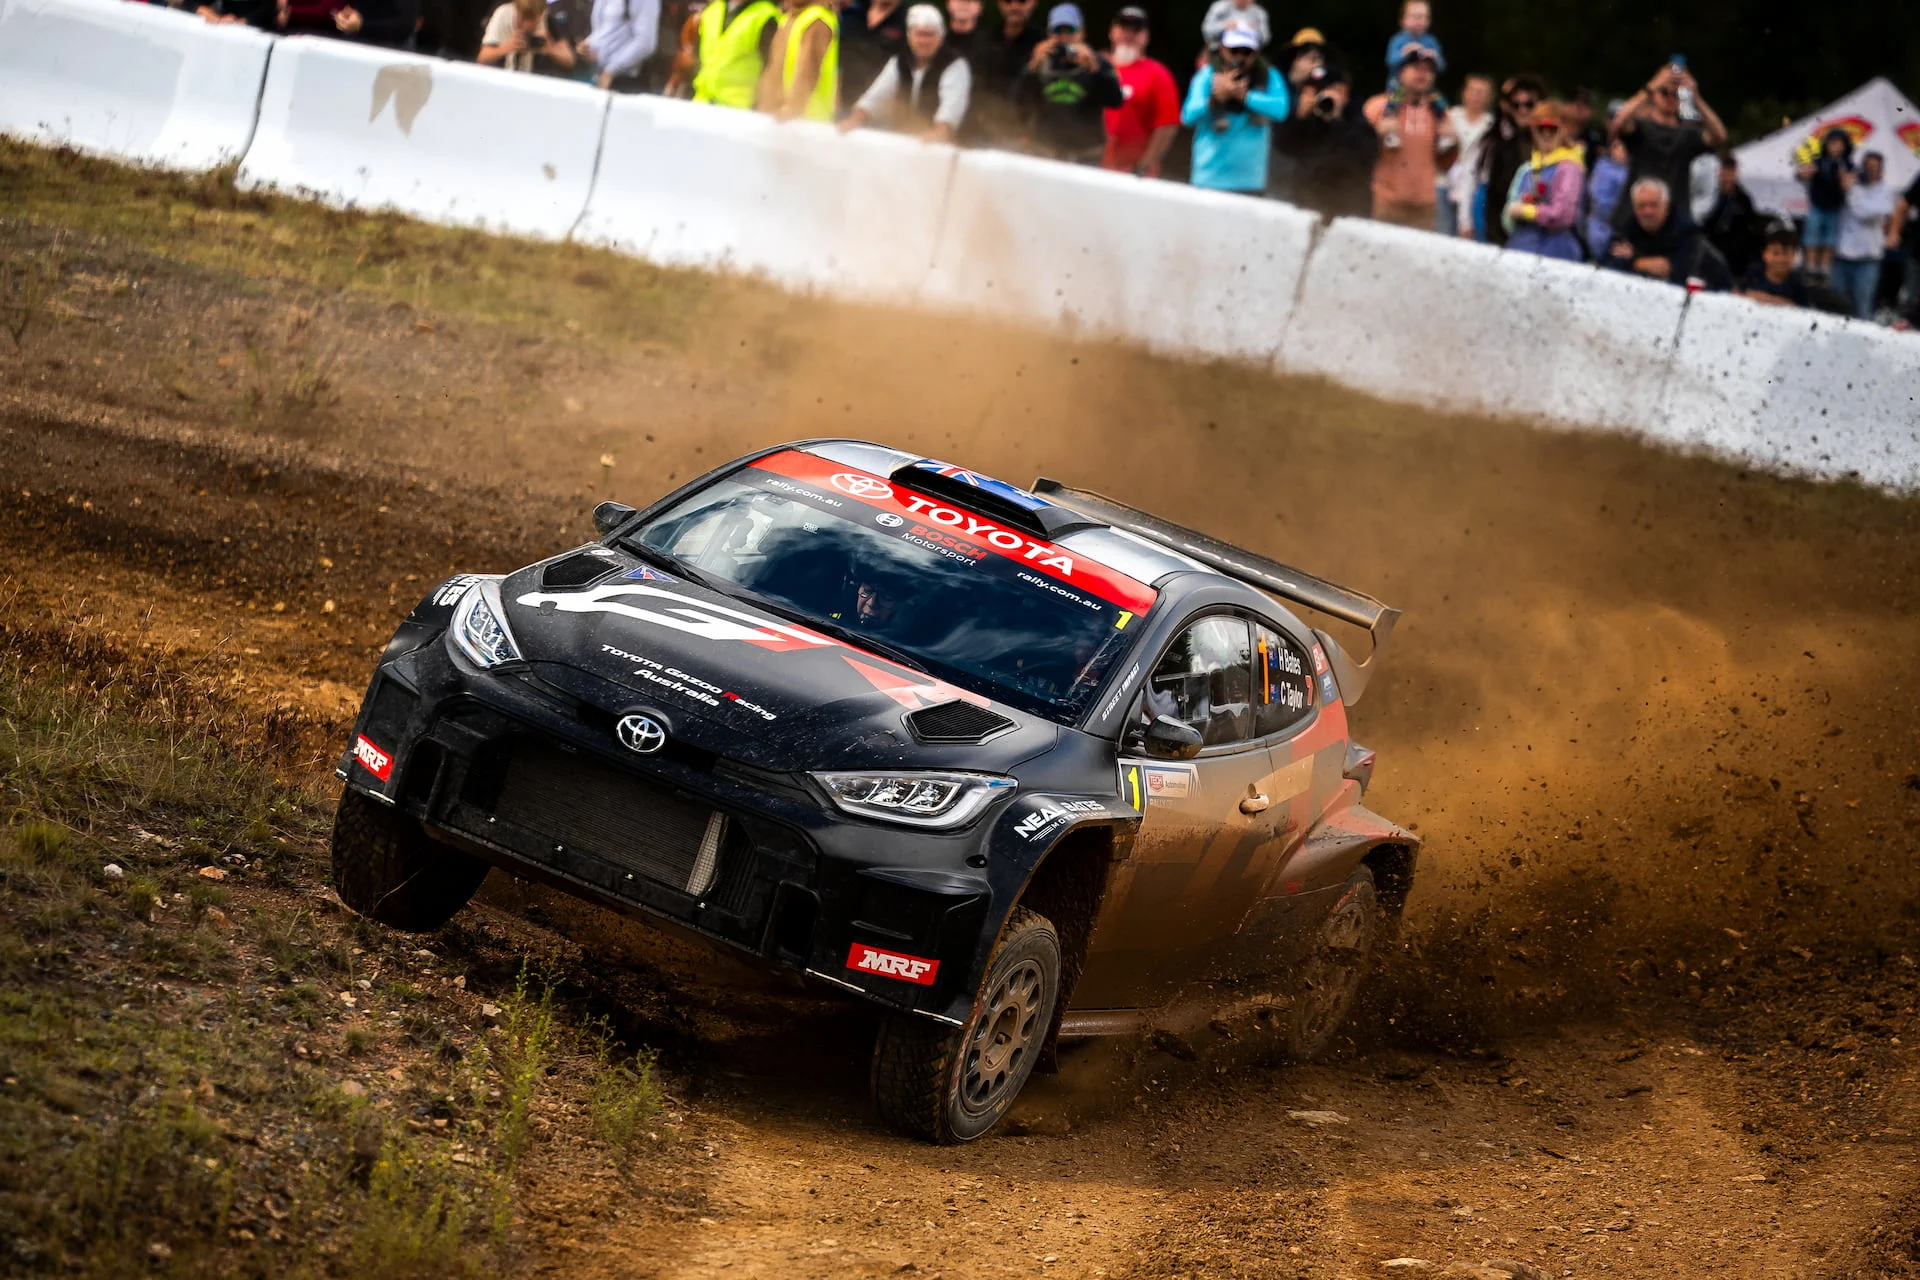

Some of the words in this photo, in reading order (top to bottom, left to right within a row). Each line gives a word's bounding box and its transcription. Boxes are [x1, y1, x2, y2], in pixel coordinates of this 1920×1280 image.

[766, 478, 842, 508] rally.com.au
[901, 532, 978, 567] Motorsport
[906, 496, 1074, 577] TOYOTA
[909, 525, 989, 561] BOSCH
[1017, 572, 1102, 611] rally.com.au
[1114, 610, 1134, 630] 1
[1258, 632, 1269, 705] 1
[1278, 647, 1285, 671] H
[1284, 648, 1302, 675] Bates
[601, 644, 664, 671] TOYOTA
[664, 667, 723, 695] GAZOO
[722, 691, 778, 721] Racing
[634, 669, 721, 707] Australia
[1102, 687, 1122, 722] STREET
[1121, 661, 1140, 692] IMPACT
[1280, 681, 1287, 705] C
[1286, 682, 1304, 712] Taylor
[353, 737, 388, 772] MRF
[1128, 766, 1140, 812] 1
[1013, 804, 1067, 839] NEAL
[858, 949, 931, 979] MRF
